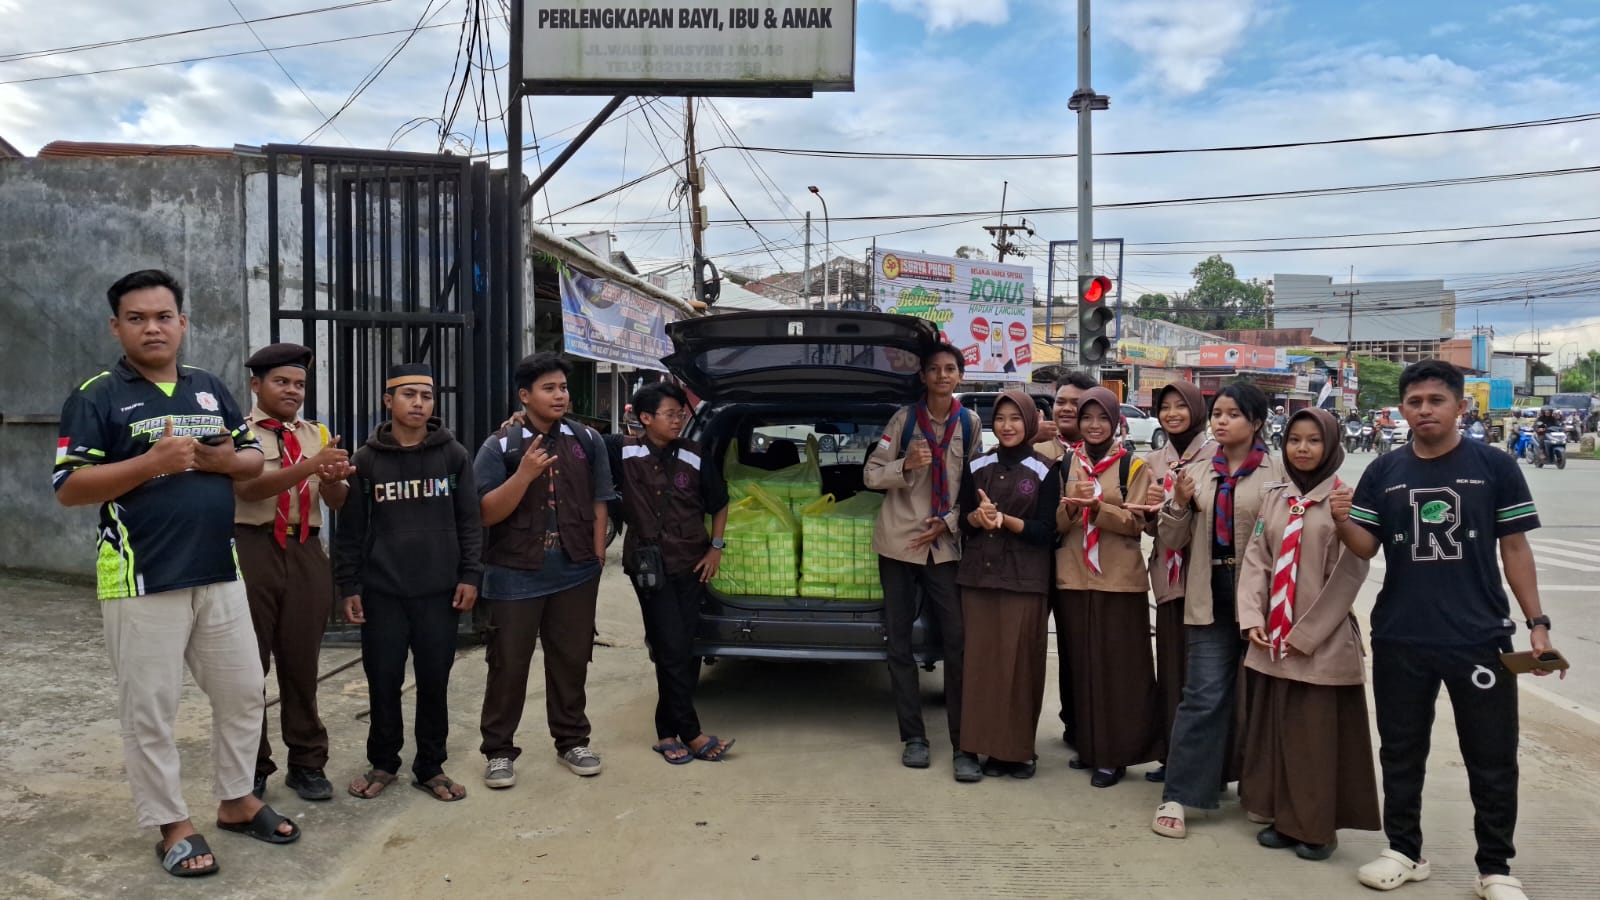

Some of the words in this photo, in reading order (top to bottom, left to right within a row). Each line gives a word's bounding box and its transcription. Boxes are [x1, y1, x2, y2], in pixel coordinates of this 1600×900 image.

[538, 8, 674, 29] PERLENGKAPAN
[678, 7, 724, 32] BAYI,
[728, 8, 760, 30] IBU
[763, 8, 778, 29] &
[782, 7, 833, 29] ANAK
[903, 259, 927, 274] SURYA
[969, 277, 1025, 304] BONUS
[173, 416, 224, 425] RESCUE
[1409, 486, 1463, 561] R
